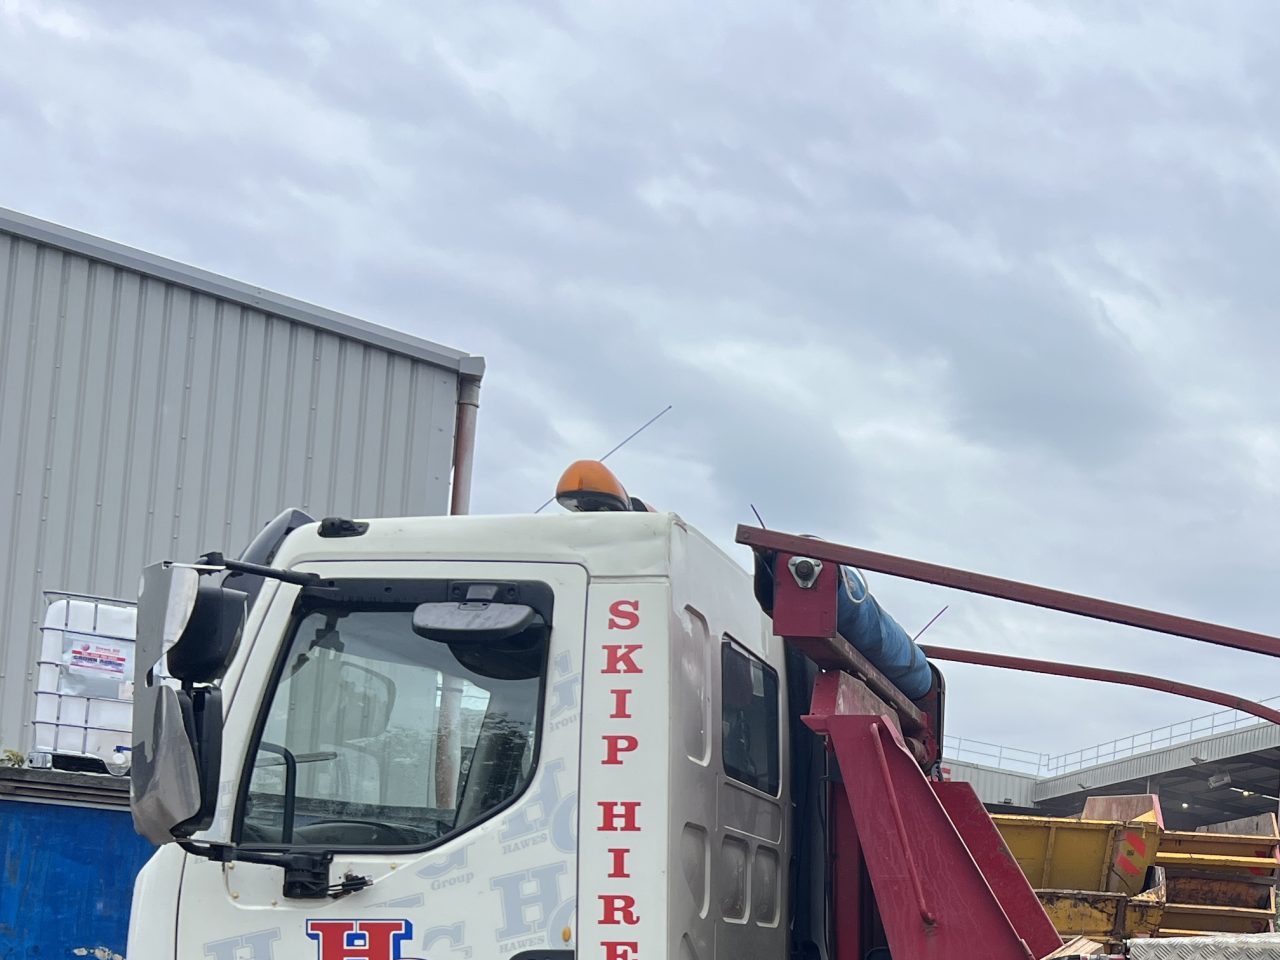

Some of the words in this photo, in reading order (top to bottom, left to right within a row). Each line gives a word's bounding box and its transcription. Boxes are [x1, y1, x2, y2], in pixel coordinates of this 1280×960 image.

[601, 600, 643, 765] SKIP
[502, 832, 548, 854] HAWES
[430, 871, 475, 891] Group
[499, 935, 546, 954] HAWES
